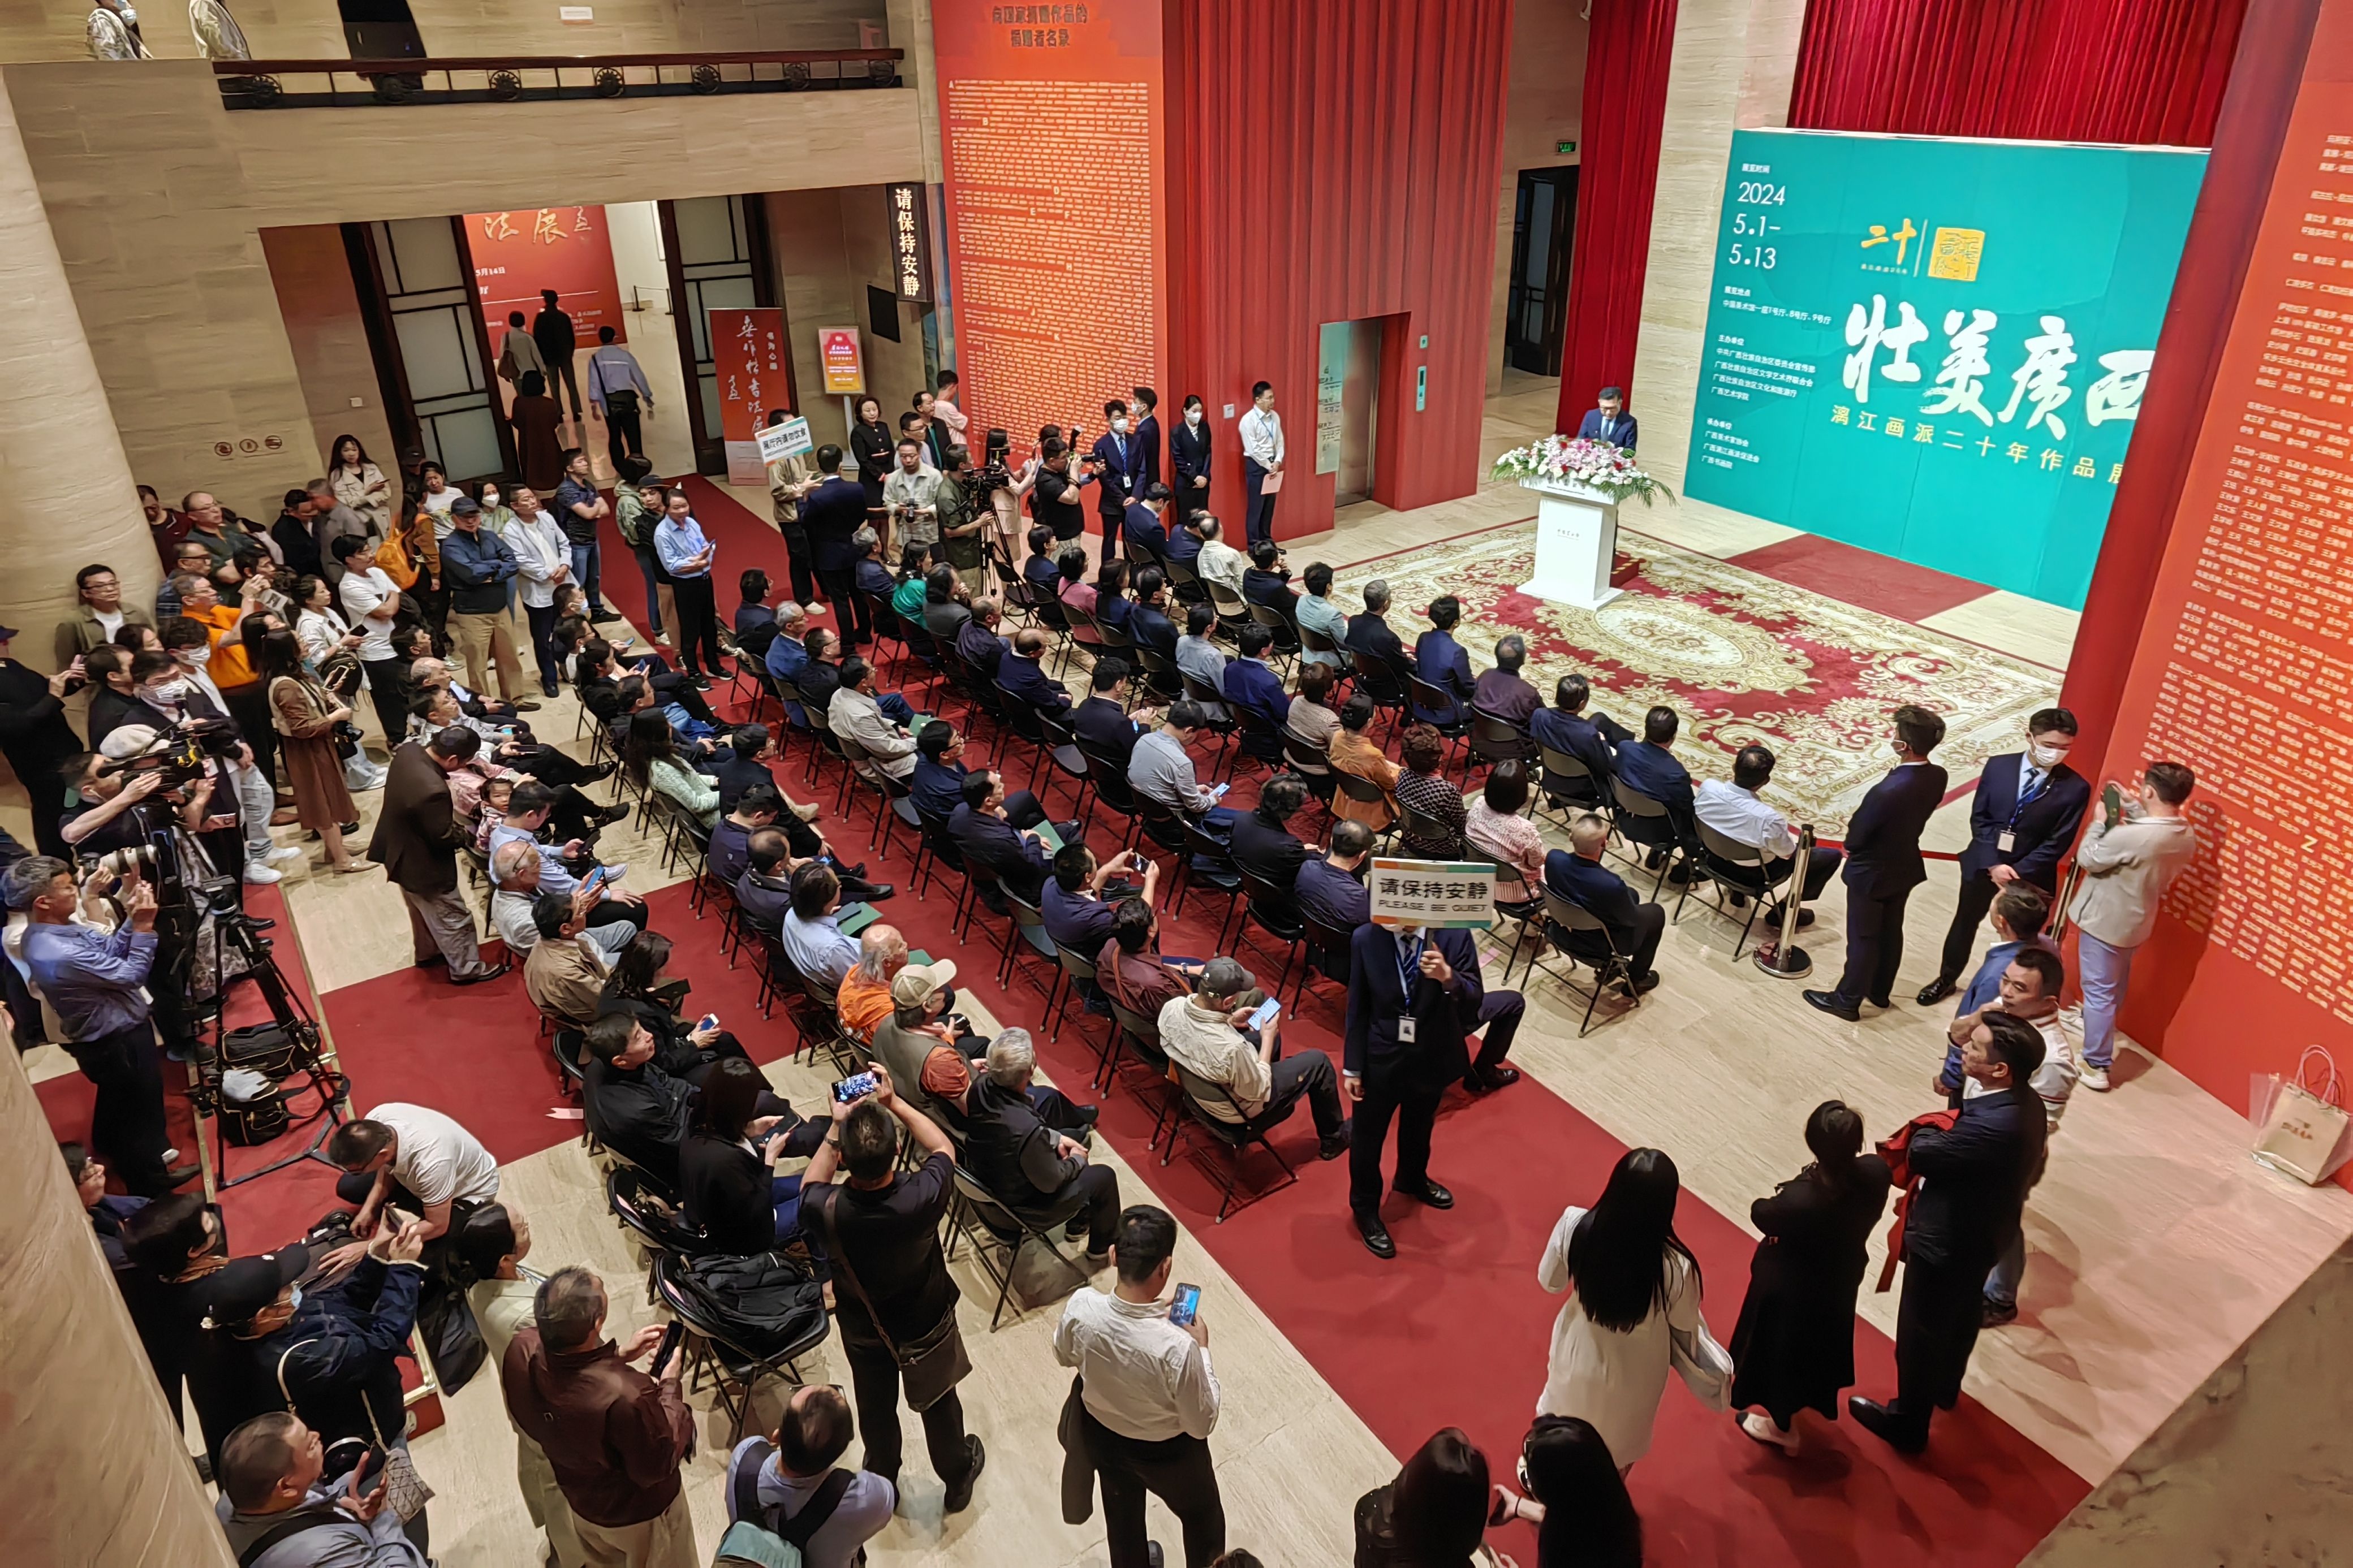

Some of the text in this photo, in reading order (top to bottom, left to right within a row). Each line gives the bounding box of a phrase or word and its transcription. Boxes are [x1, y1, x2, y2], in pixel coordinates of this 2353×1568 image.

[949, 80, 954, 89] A
[982, 116, 989, 126] B
[953, 140, 959, 148] C
[1737, 181, 1786, 206] 2024
[1030, 207, 1036, 215] E
[1065, 210, 1070, 219] F
[895, 188, 920, 297] 请保持安静
[959, 234, 965, 243] G
[1861, 217, 1917, 265] 二十
[1728, 243, 1777, 270] 5.13
[1054, 332, 1060, 341] K
[1718, 334, 1744, 346] 主办单位
[1378, 878, 1488, 900] 请保持安静
[1377, 899, 1426, 911] PLEASE
